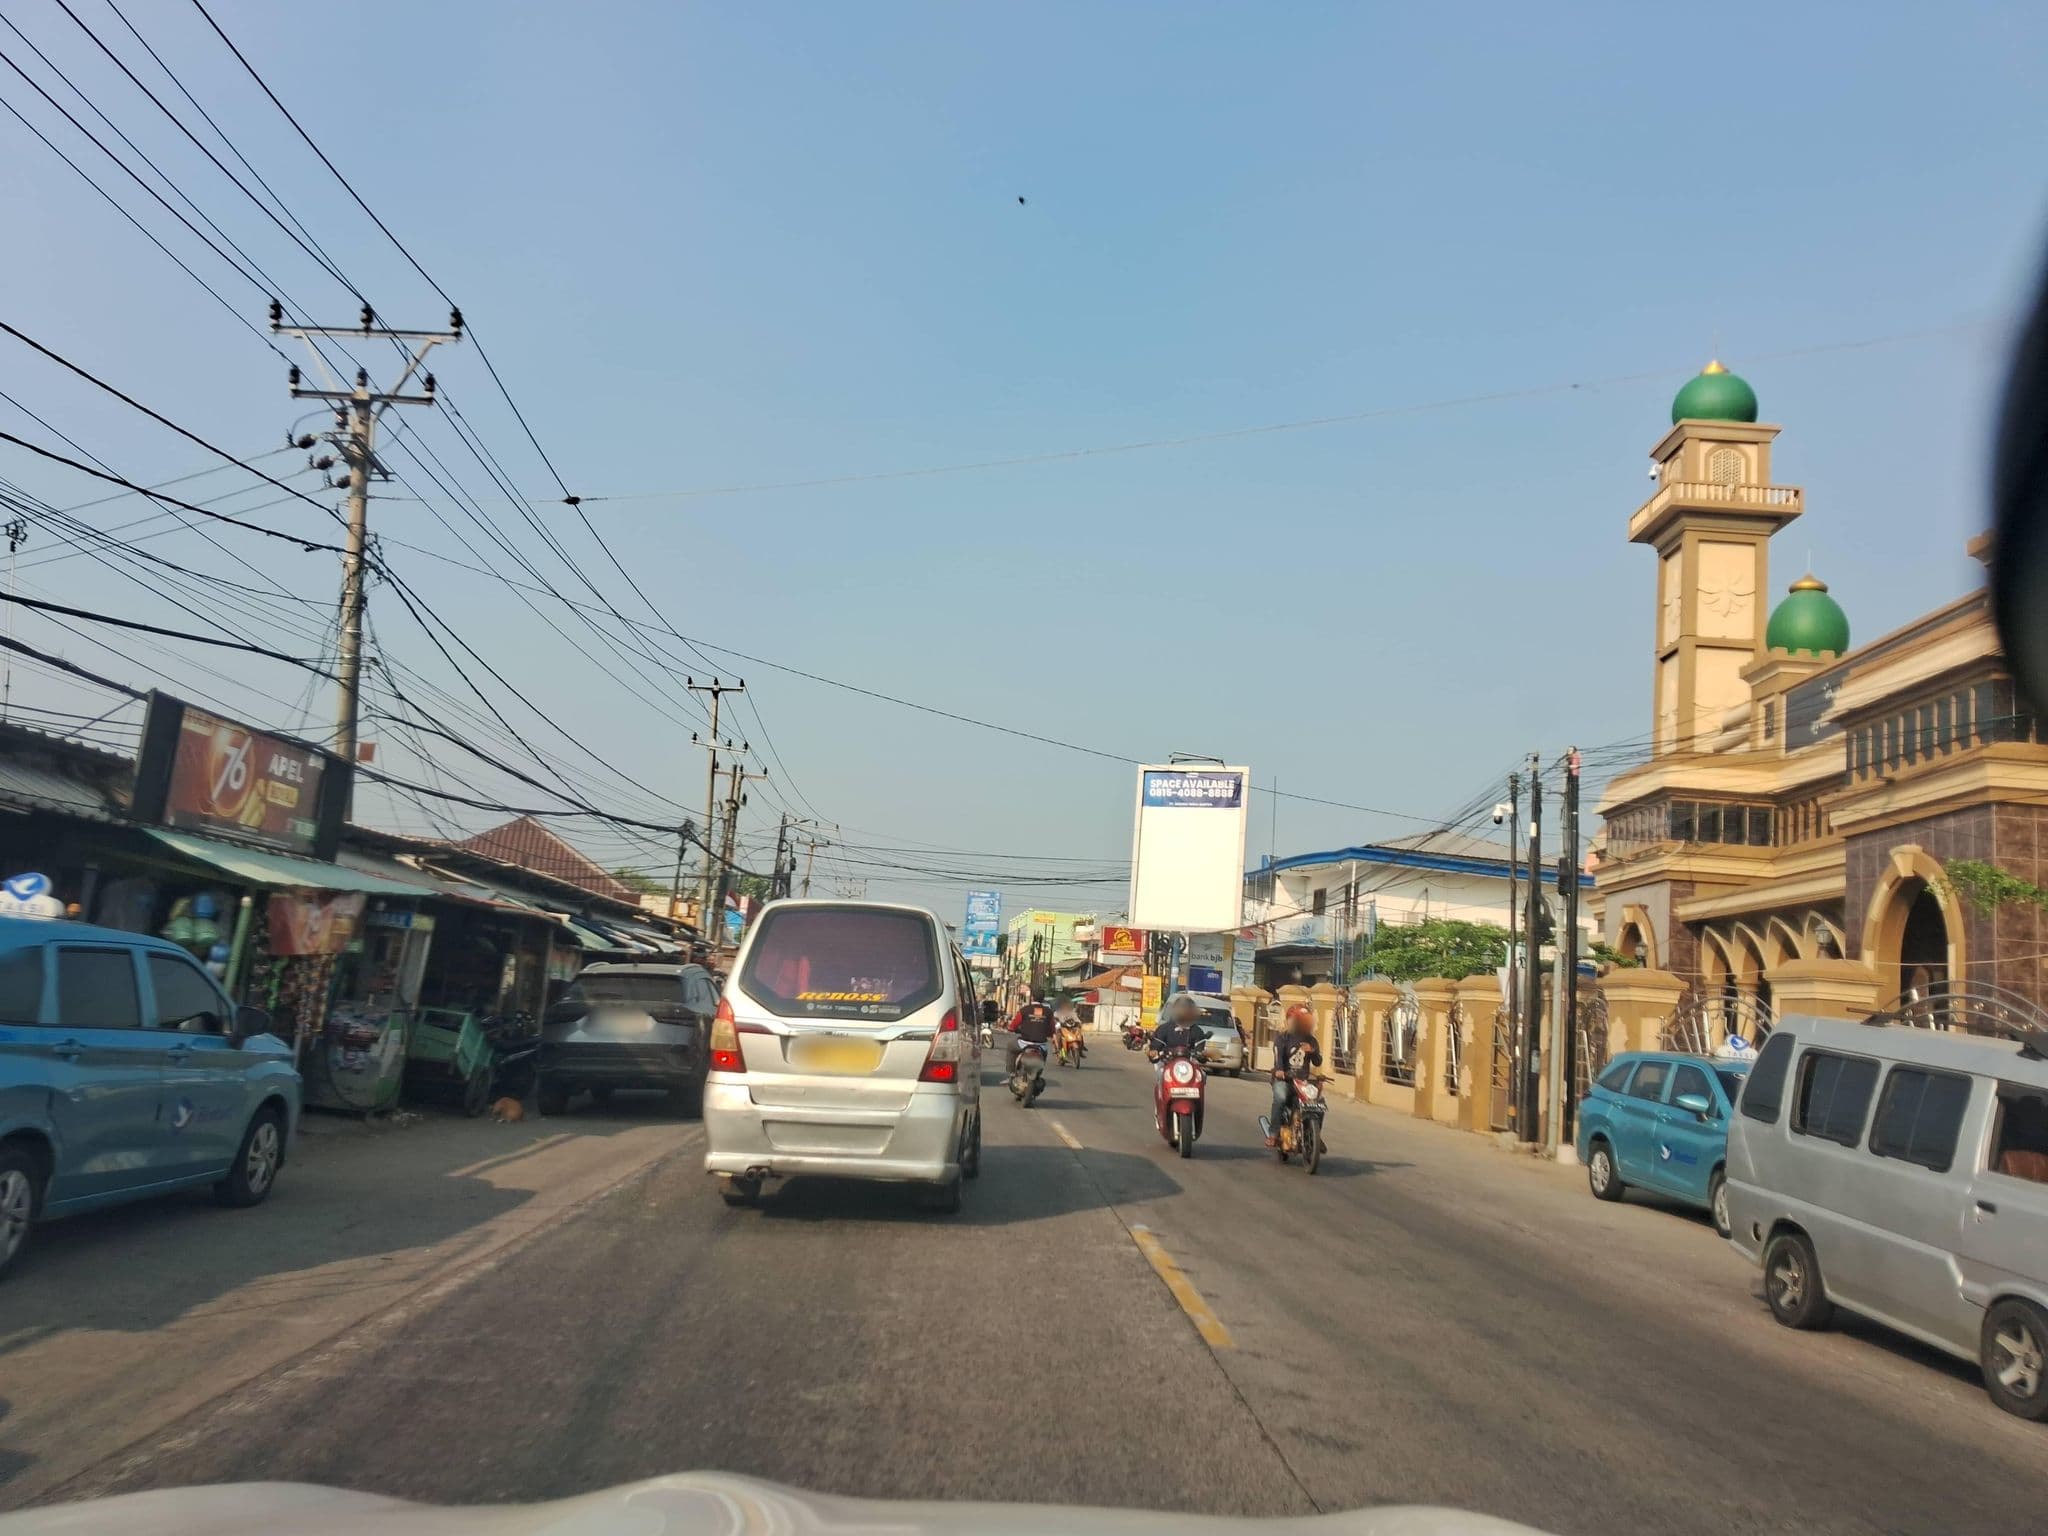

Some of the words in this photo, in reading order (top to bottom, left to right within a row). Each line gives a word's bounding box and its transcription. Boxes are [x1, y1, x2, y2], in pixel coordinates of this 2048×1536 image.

[212, 735, 254, 801] 76
[268, 753, 304, 783] APEL
[1150, 779, 1181, 789] SPACE
[1182, 779, 1235, 789] AVAILABLE
[1191, 951, 1209, 961] bank
[1210, 953, 1223, 963] bjb
